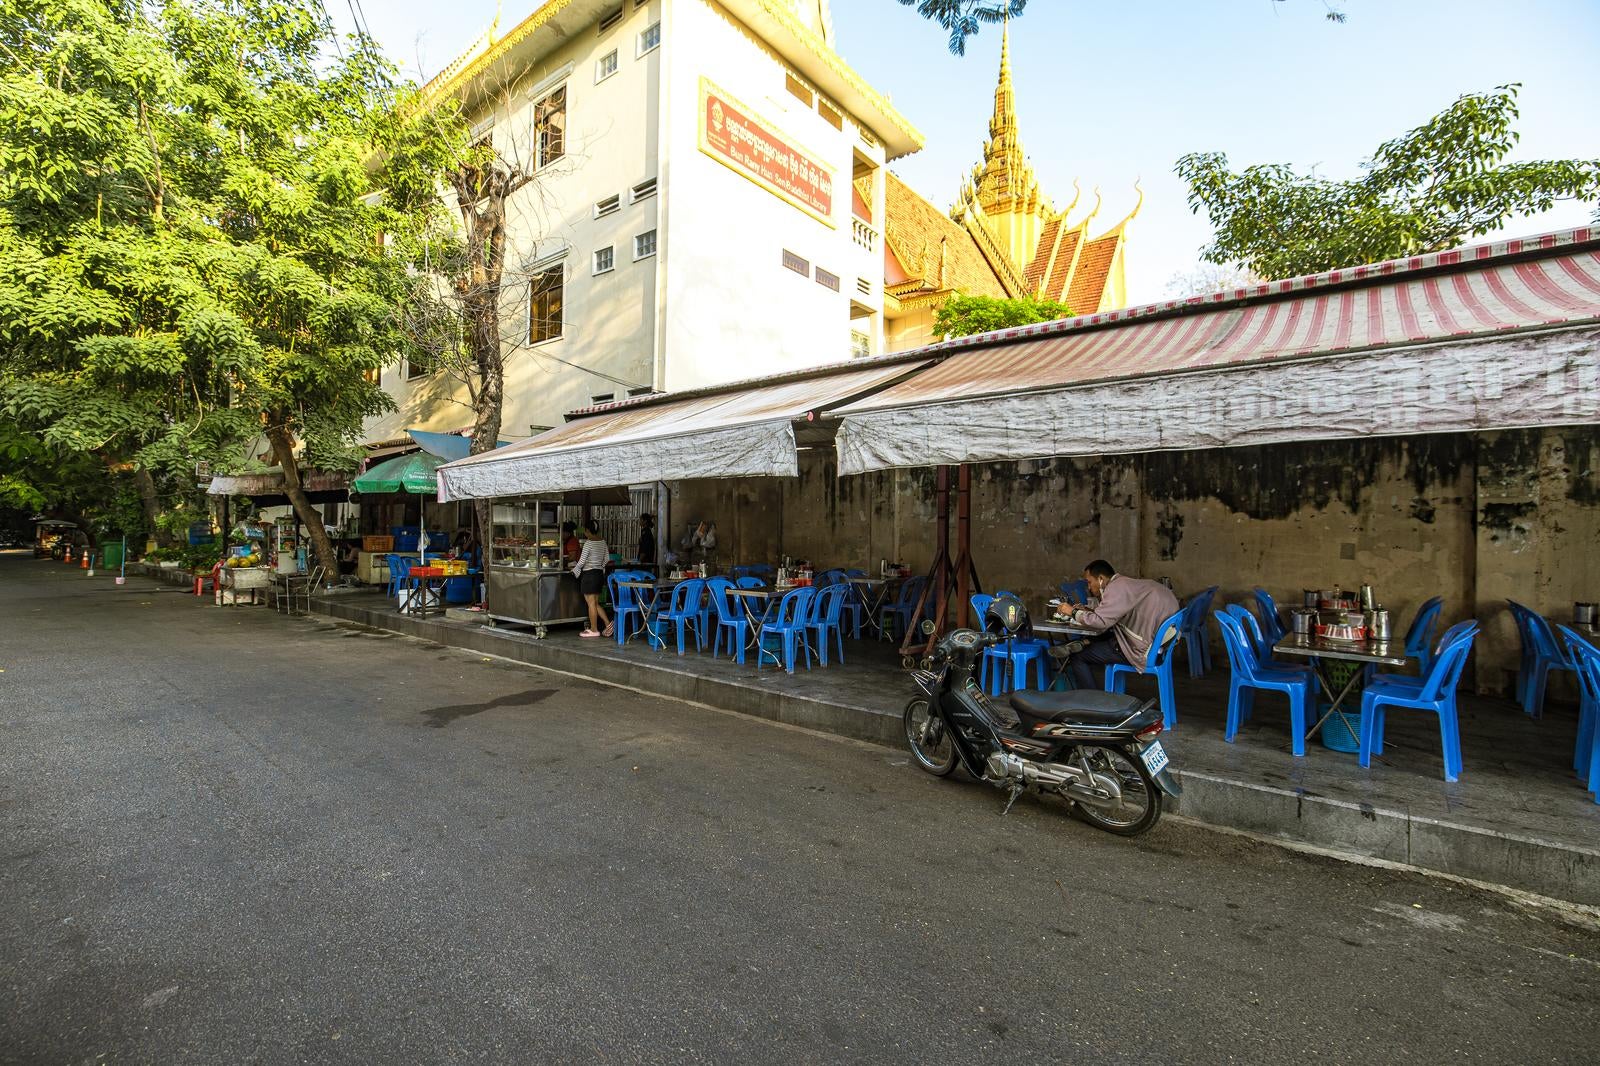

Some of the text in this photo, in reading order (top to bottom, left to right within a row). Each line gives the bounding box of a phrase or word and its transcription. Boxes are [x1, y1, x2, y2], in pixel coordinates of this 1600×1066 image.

[730, 144, 827, 214] Bun Rany Hun Sen Buddhist Library
